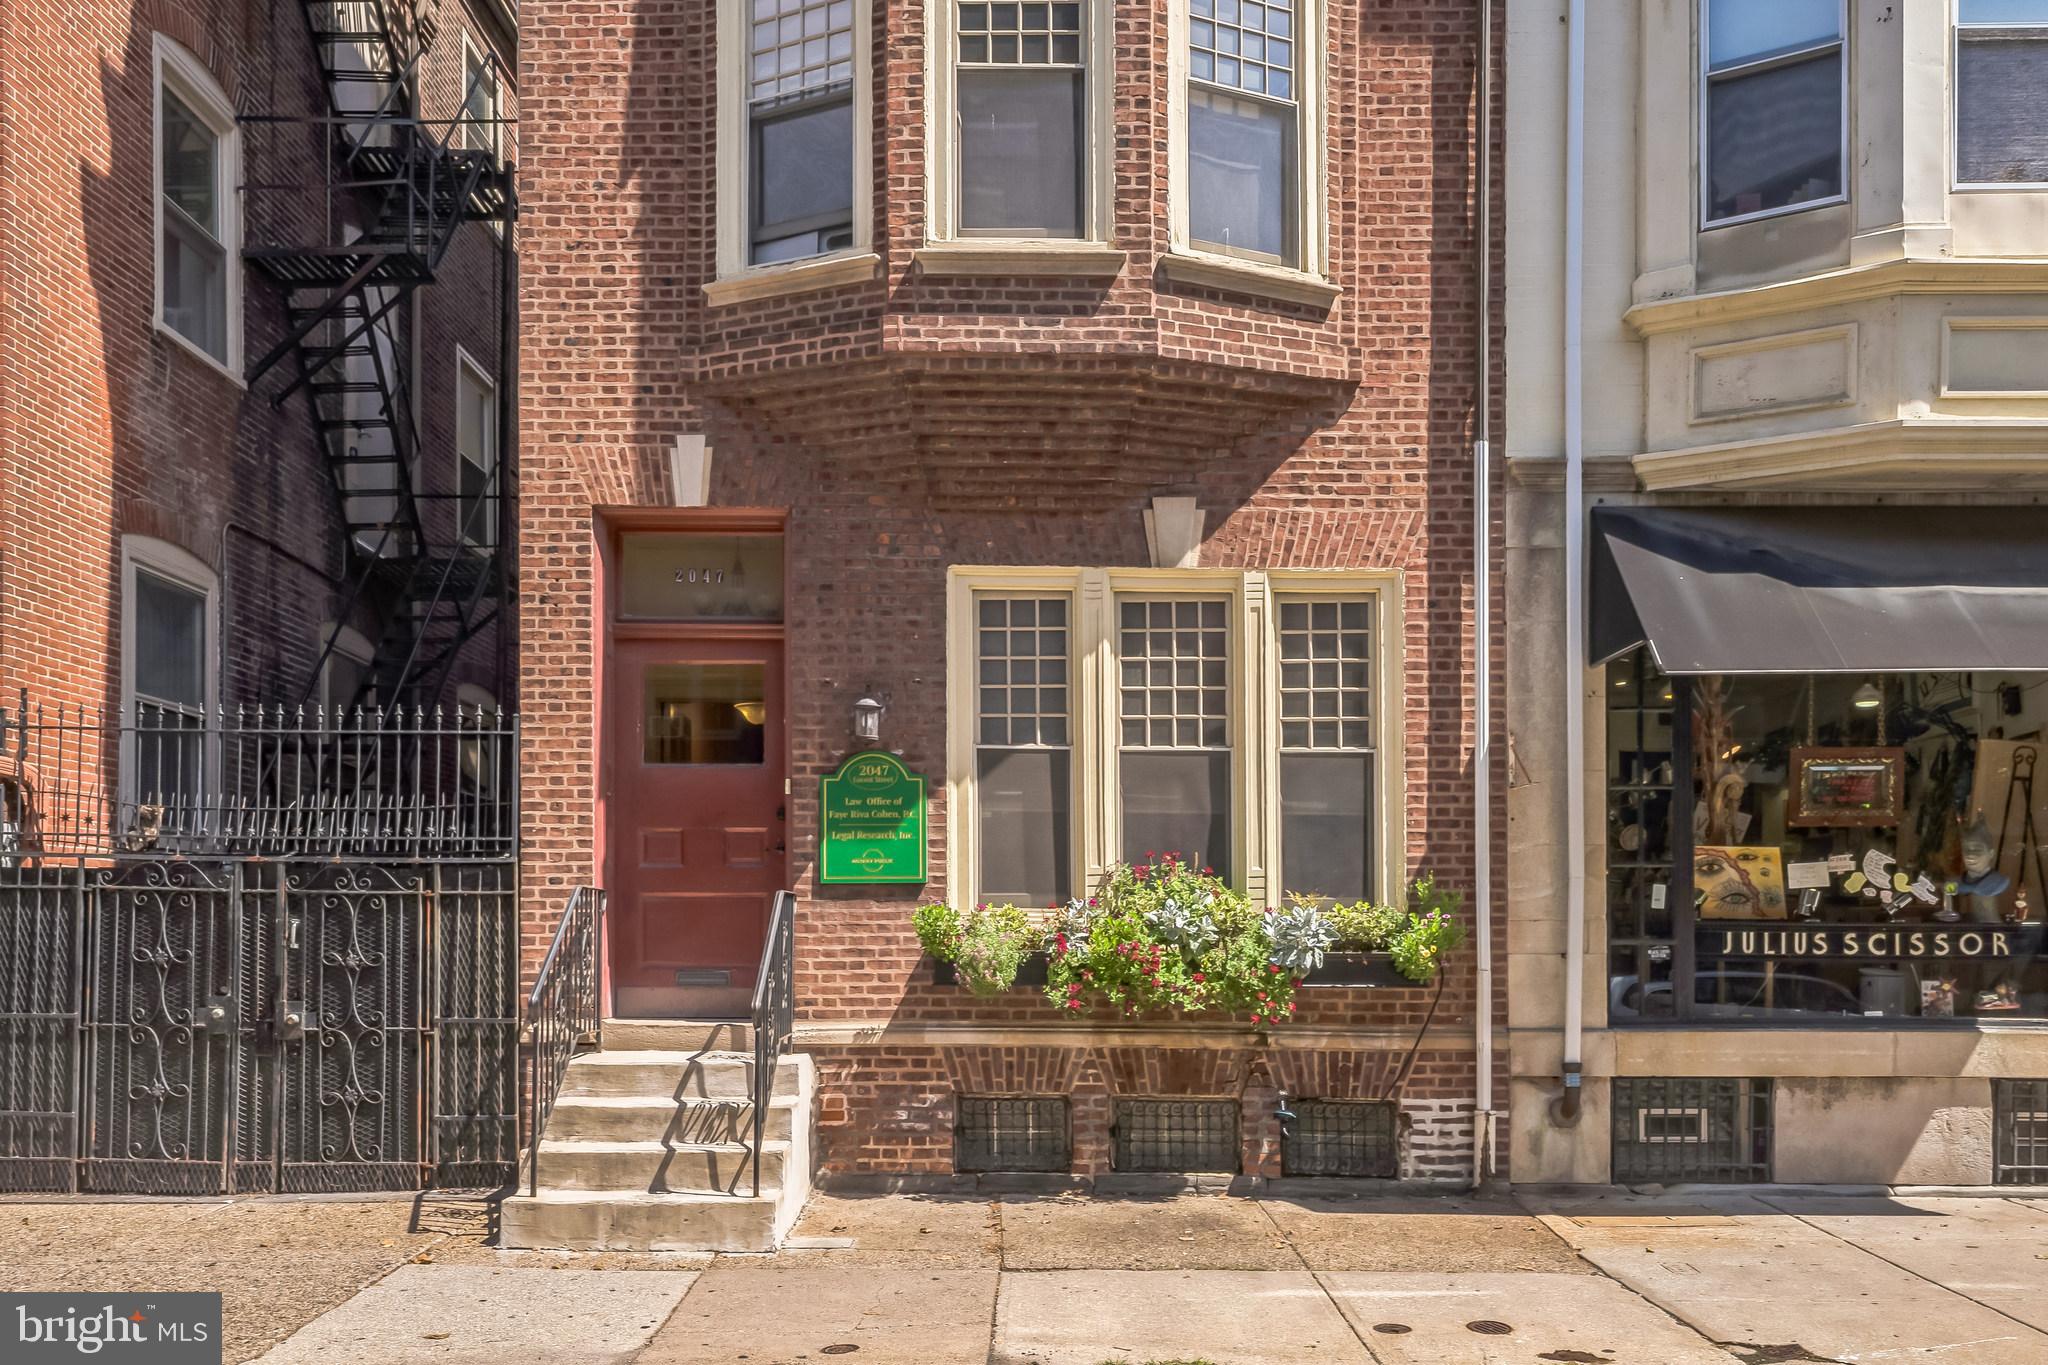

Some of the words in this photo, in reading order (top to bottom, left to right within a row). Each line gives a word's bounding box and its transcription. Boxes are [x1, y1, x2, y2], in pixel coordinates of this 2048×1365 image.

[675, 569, 724, 583] 2047
[859, 765, 889, 776] 2047
[845, 797, 862, 806] Law
[866, 797, 892, 806] Office
[892, 797, 903, 806] of
[829, 810, 848, 820] Faye
[831, 831, 855, 841] Legal
[856, 831, 897, 841] Research,
[1722, 931, 1828, 956] JULIUS
[1843, 932, 2011, 956] SCISSOR
